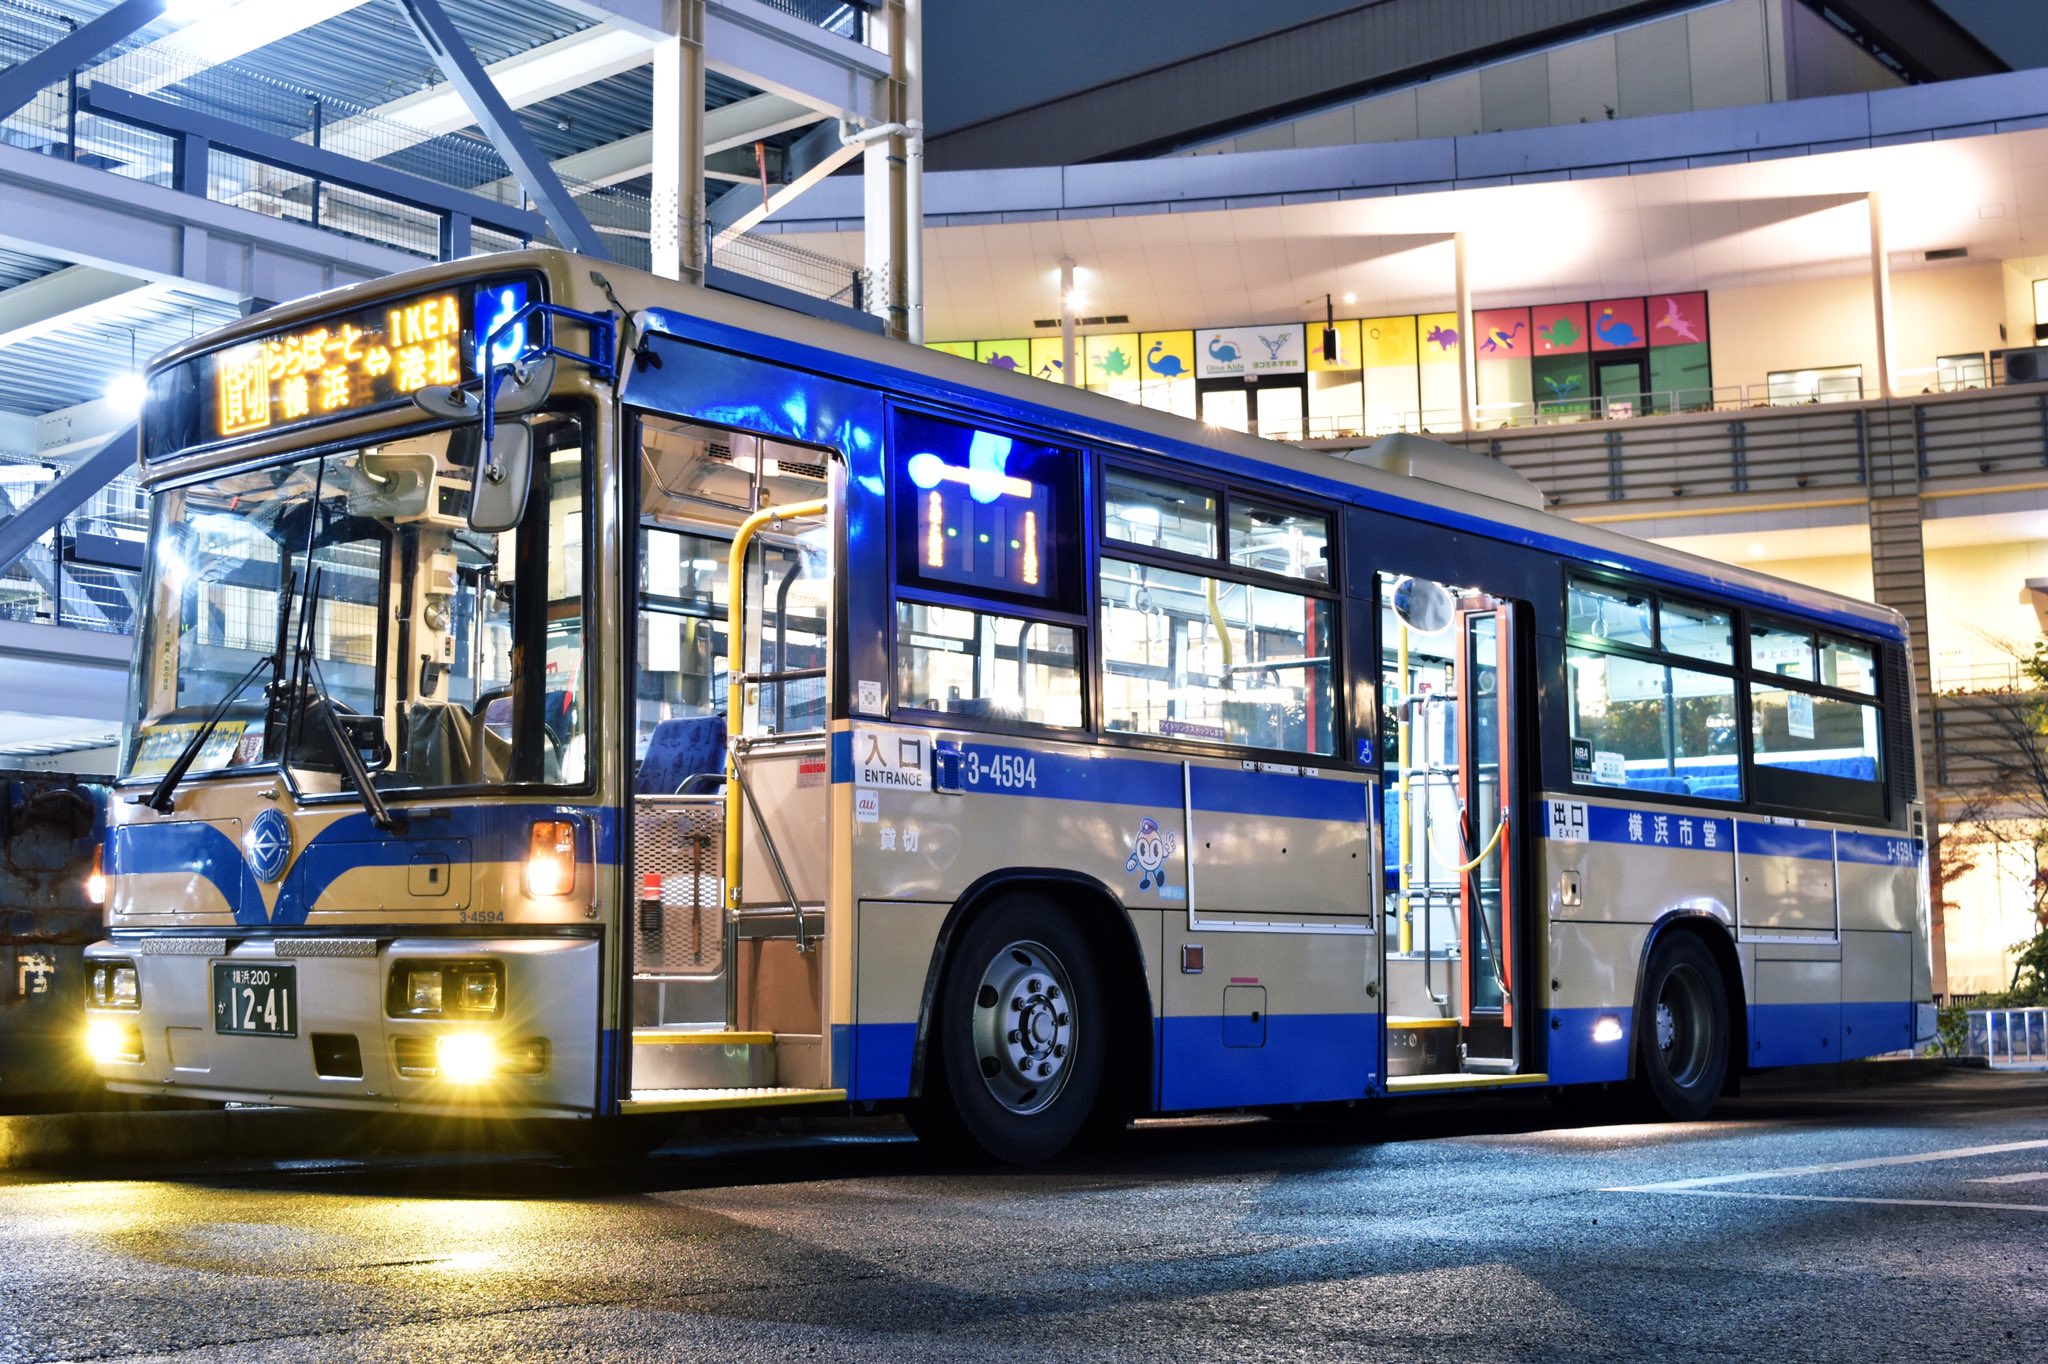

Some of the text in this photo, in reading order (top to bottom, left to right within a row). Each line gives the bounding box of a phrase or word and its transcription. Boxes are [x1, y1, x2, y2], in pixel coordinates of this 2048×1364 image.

[390, 296, 458, 347] IKEA
[269, 324, 363, 380] ららぽーと
[400, 341, 457, 391] 港北
[282, 365, 349, 418] 横浜
[865, 735, 921, 770] 入口
[1575, 747, 1588, 760] NBA
[864, 769, 923, 787] ENTRANCE
[967, 752, 1037, 788] 3-4594
[858, 799, 877, 810] au
[1554, 803, 1584, 828] 出口
[880, 828, 919, 853] 貸切
[1559, 828, 1580, 838] EXIT
[1628, 813, 1717, 848] 横浜市営
[1887, 841, 1913, 861] 3-4594
[218, 1001, 227, 1015] か
